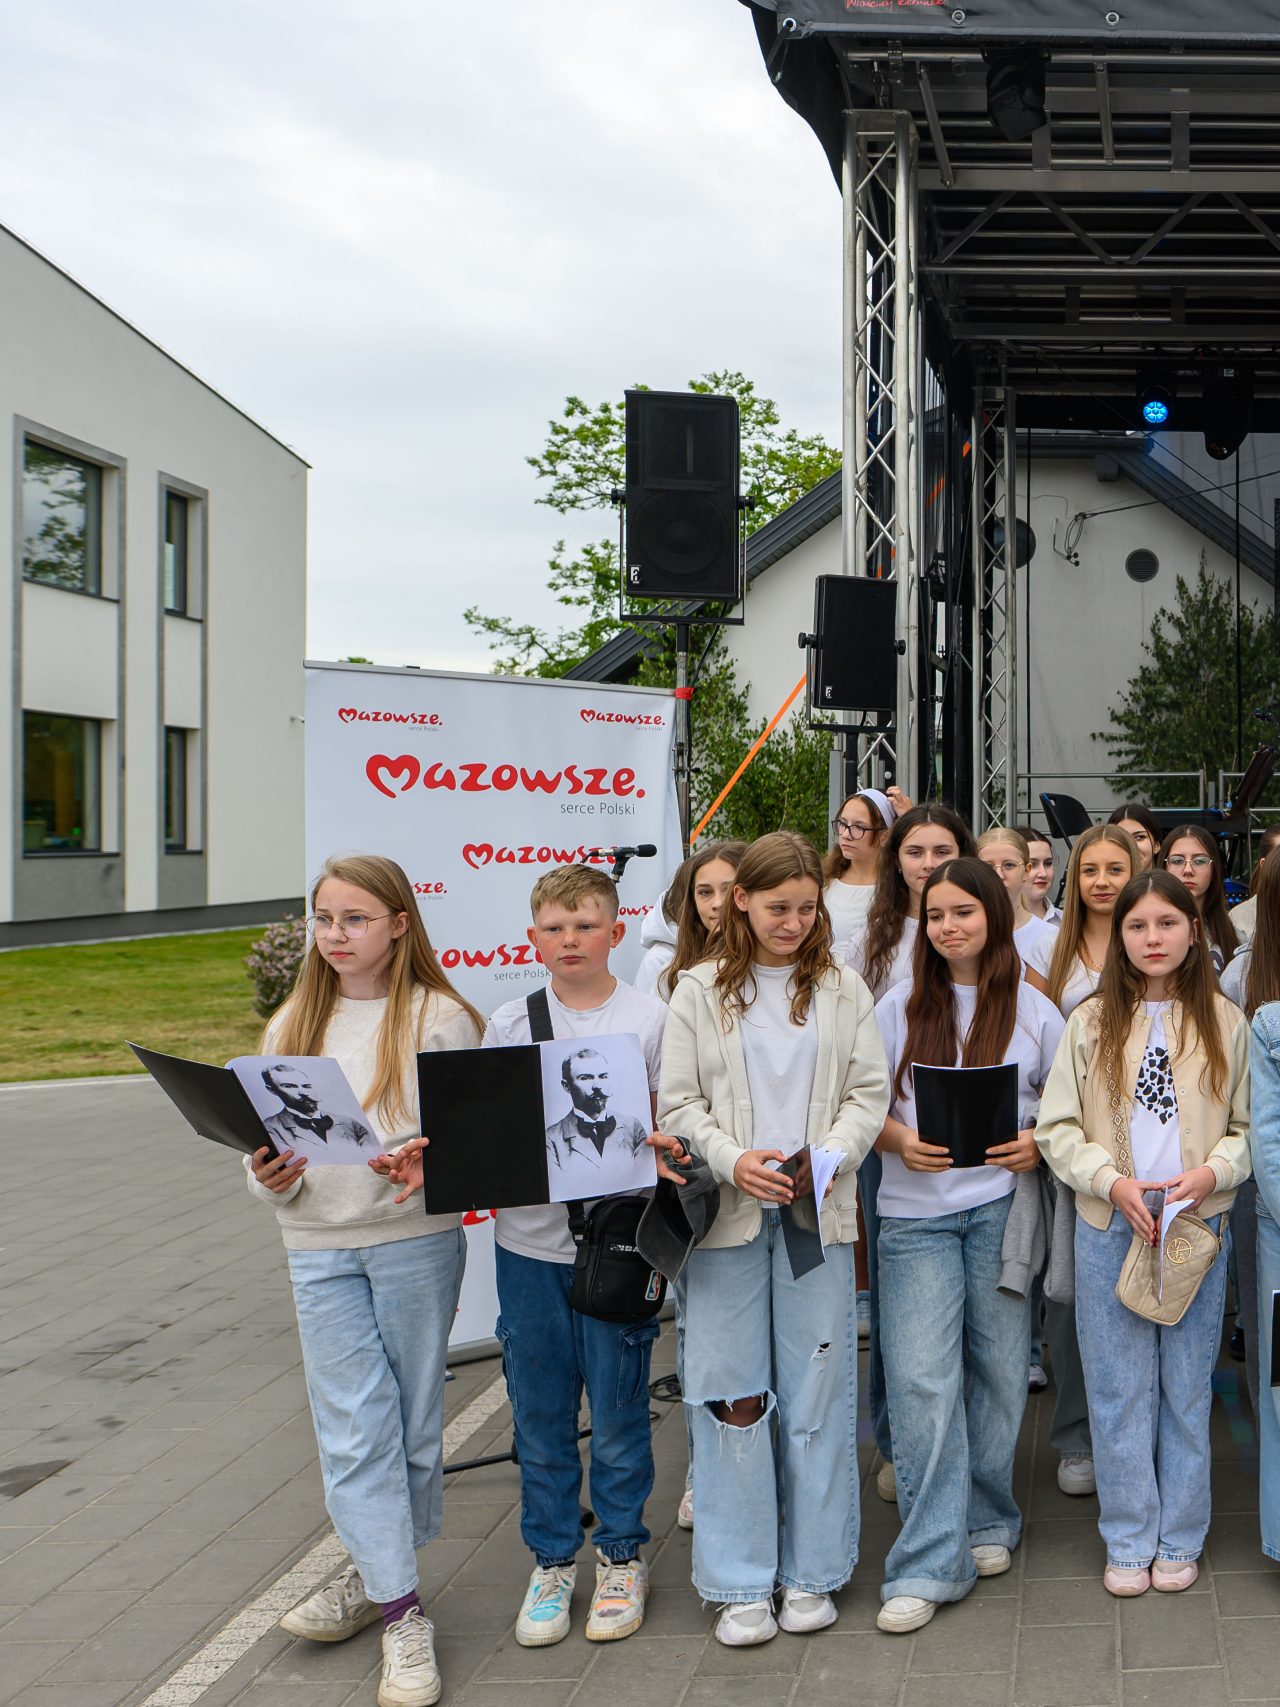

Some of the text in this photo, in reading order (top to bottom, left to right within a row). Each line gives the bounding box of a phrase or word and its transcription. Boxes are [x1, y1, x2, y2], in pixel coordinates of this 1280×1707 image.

[366, 754, 646, 799] Mazowsze.
[560, 802, 635, 816] serce Polski
[494, 968, 551, 981] serce Polsk
